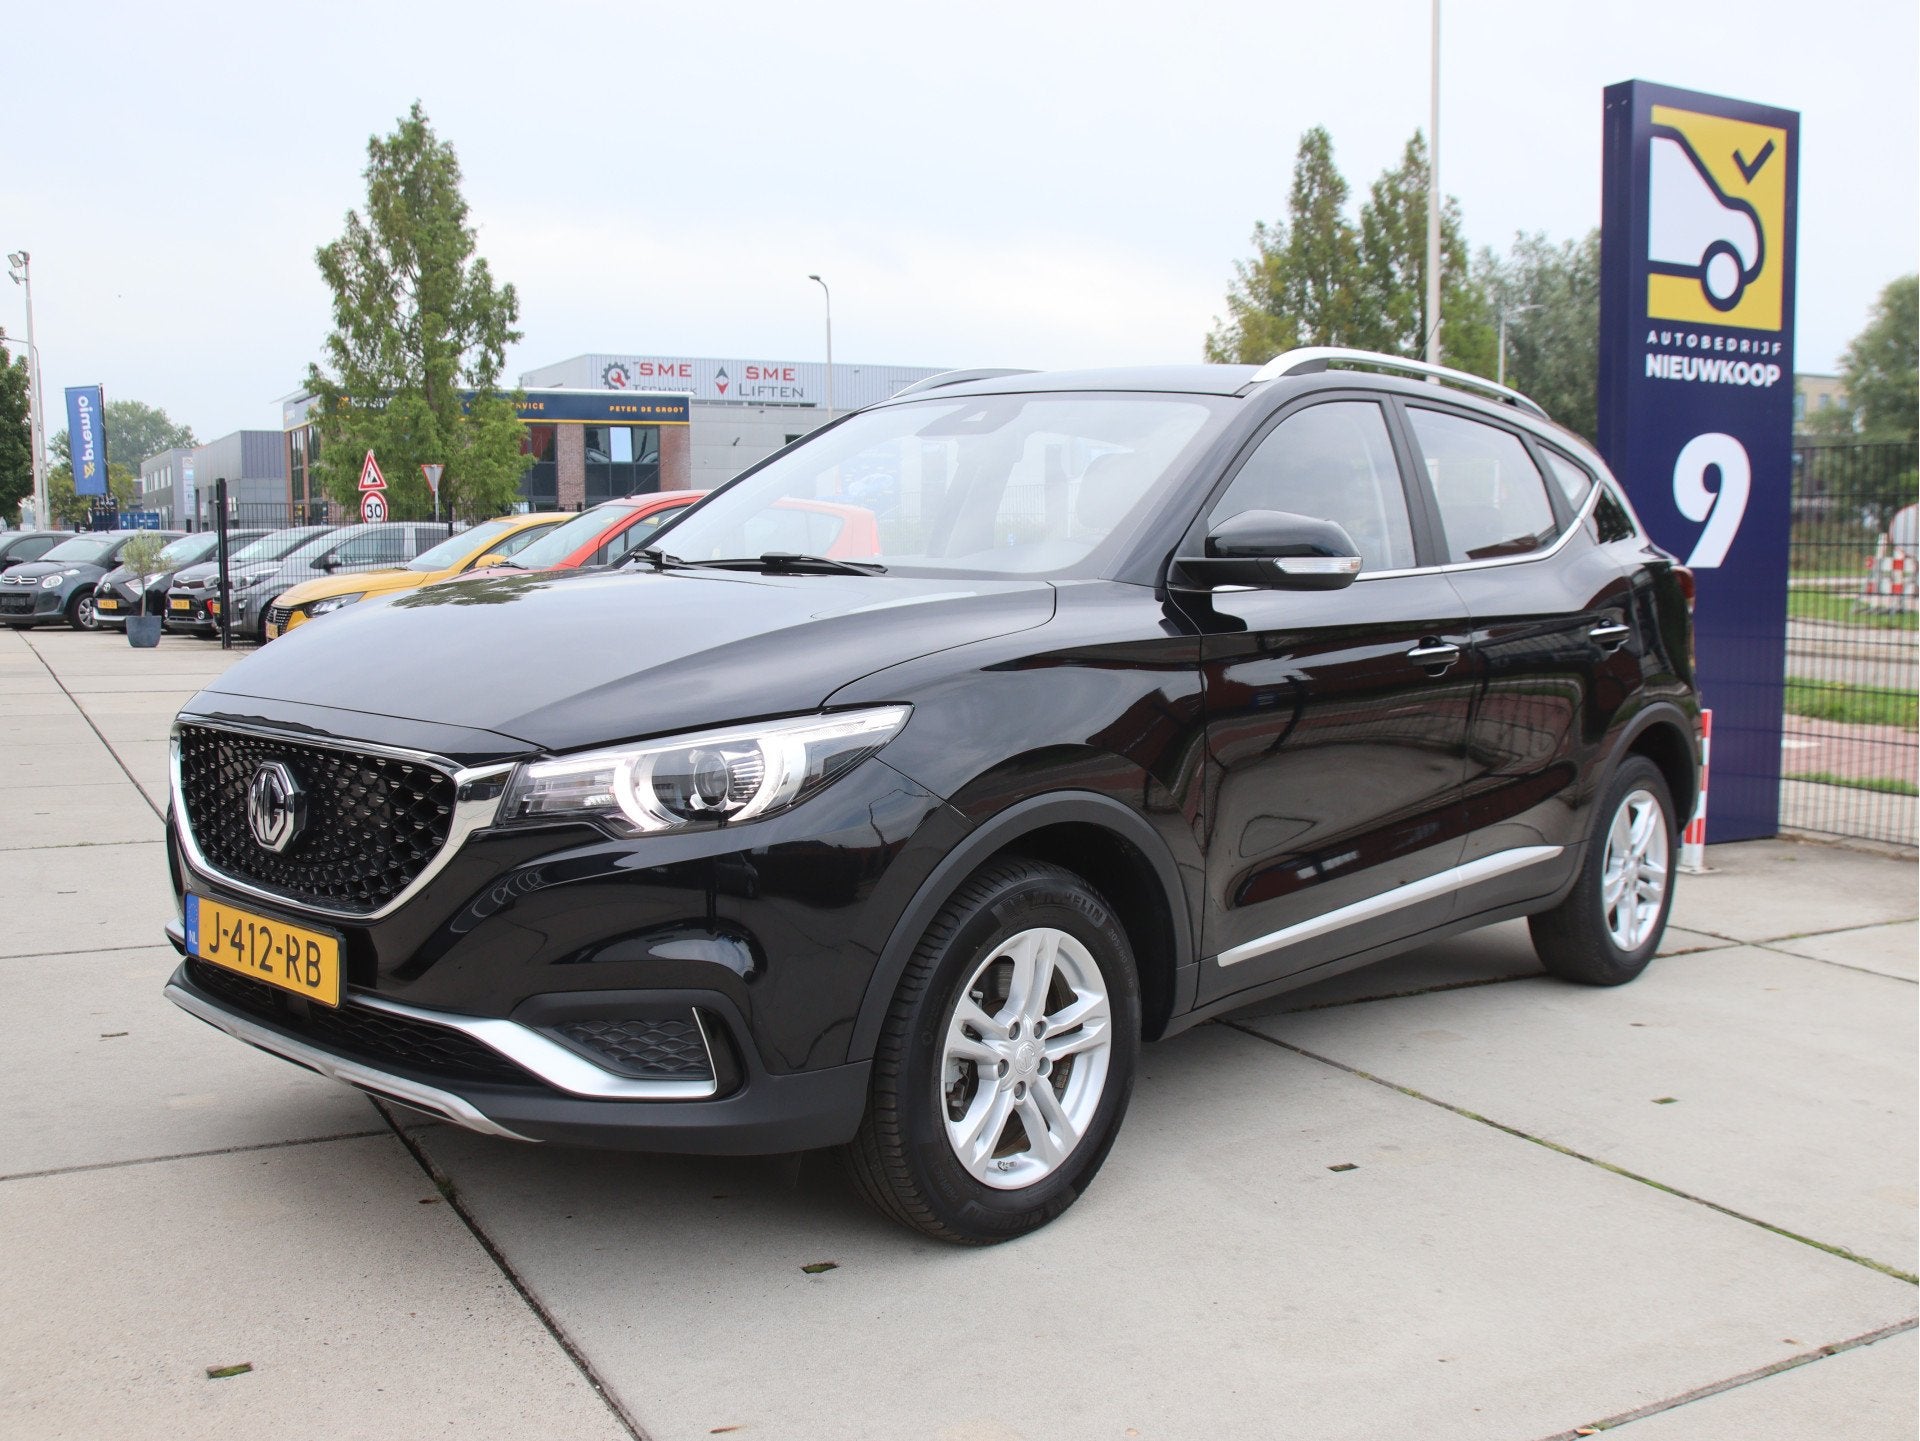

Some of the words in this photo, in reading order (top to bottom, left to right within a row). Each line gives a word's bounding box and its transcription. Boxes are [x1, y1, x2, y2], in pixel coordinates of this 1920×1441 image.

[1646, 330, 1783, 356] AUTOBEDRIJF
[639, 362, 692, 378] SME
[745, 365, 795, 382] SME
[1645, 353, 1782, 388] NIEUWKOOP
[738, 382, 804, 398] LIFTEN
[609, 405, 637, 413] PETER
[1672, 432, 1752, 569] 9
[366, 503, 383, 519] 30
[249, 764, 289, 848] MG
[188, 929, 198, 945] NL
[209, 911, 322, 988] J-412-RB
